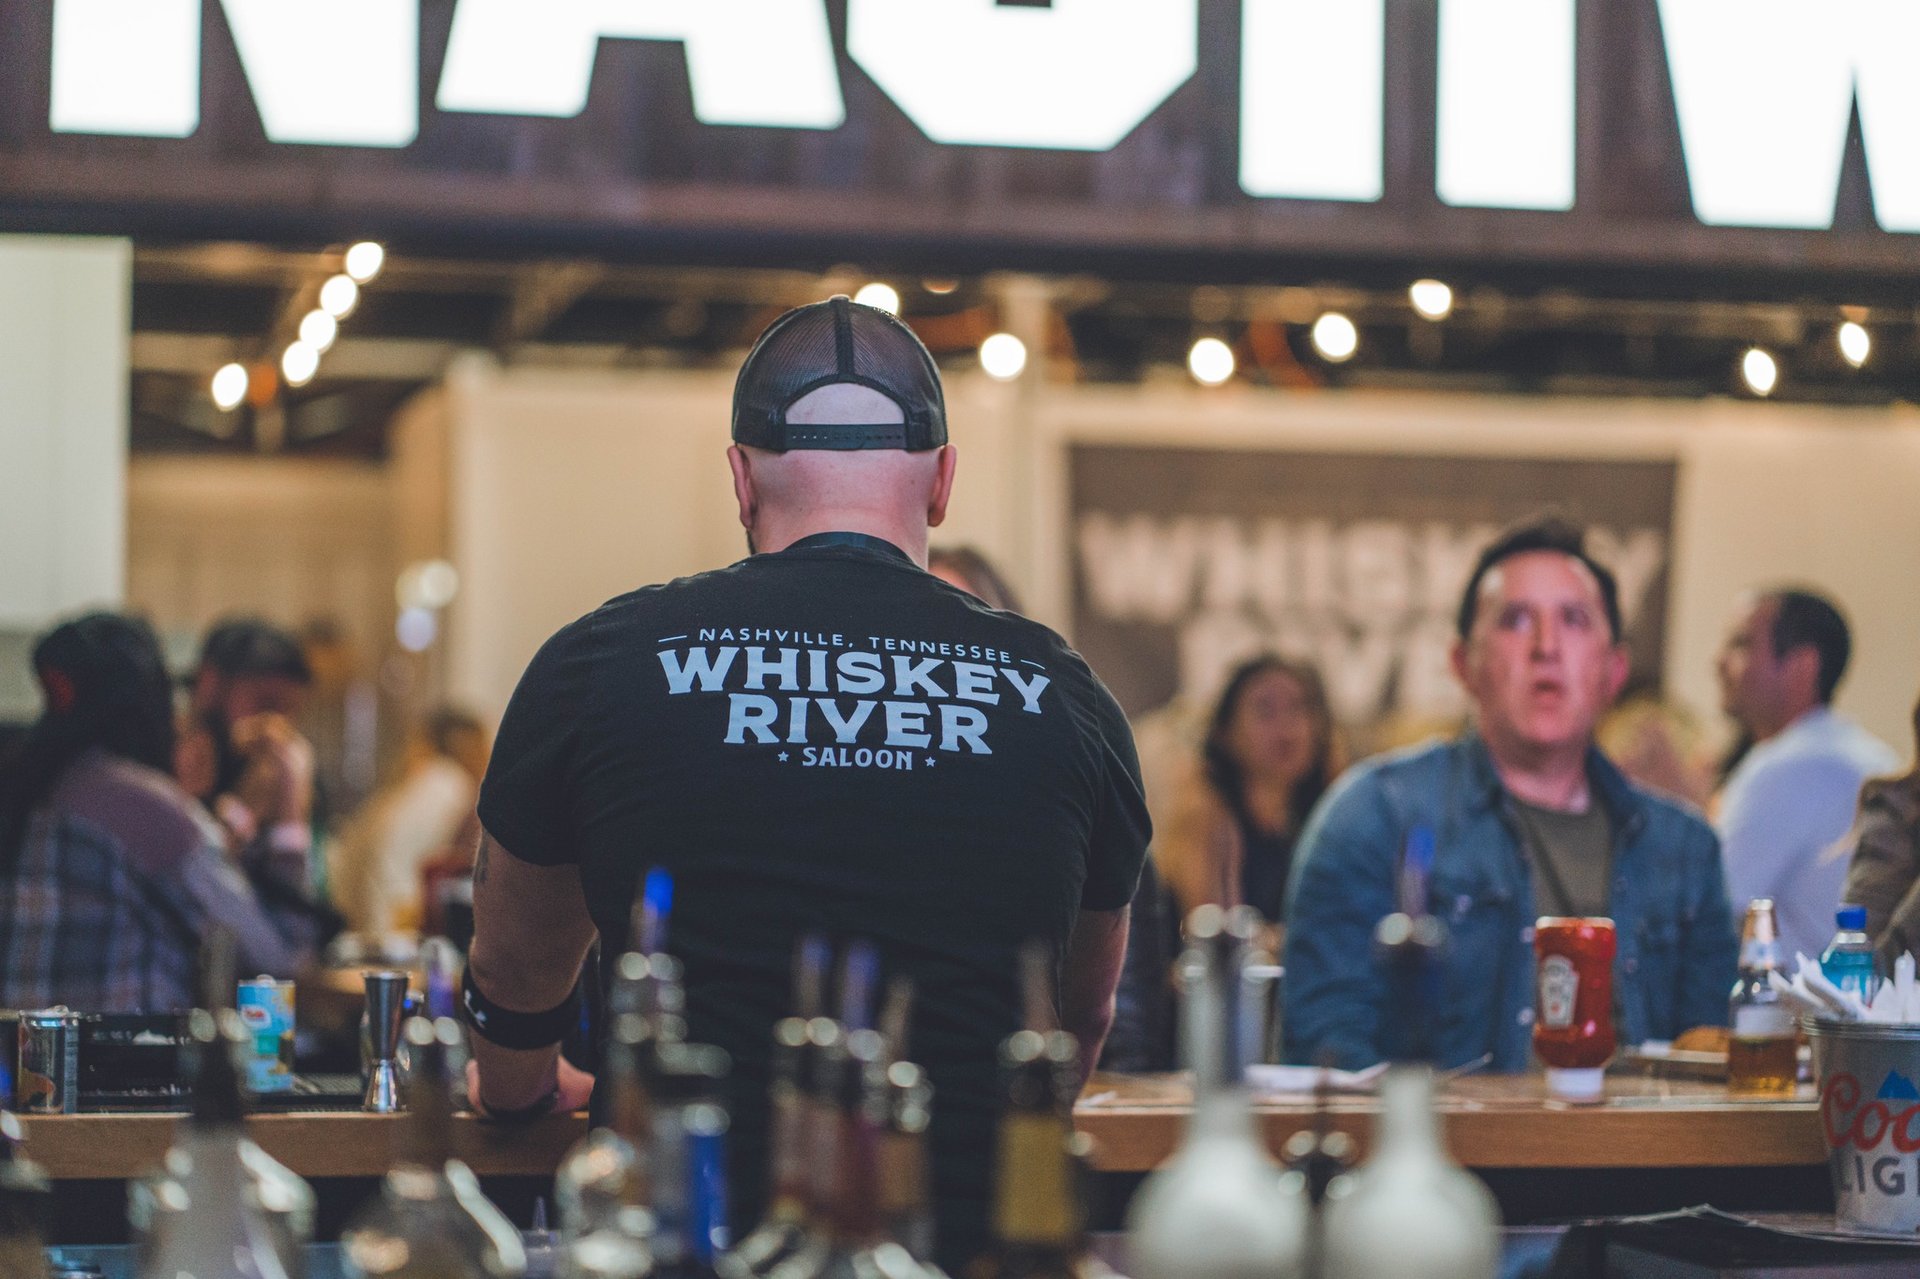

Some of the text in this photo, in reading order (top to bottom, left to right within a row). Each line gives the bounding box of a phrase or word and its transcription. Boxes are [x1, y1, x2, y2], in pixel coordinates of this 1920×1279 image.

[699, 627, 1012, 663] NASHVILLE, TENNESSEE
[657, 646, 1051, 714] WHISKEY
[723, 692, 993, 755] RIVER
[802, 746, 913, 771] SALOON
[1823, 1072, 1920, 1154] Coo
